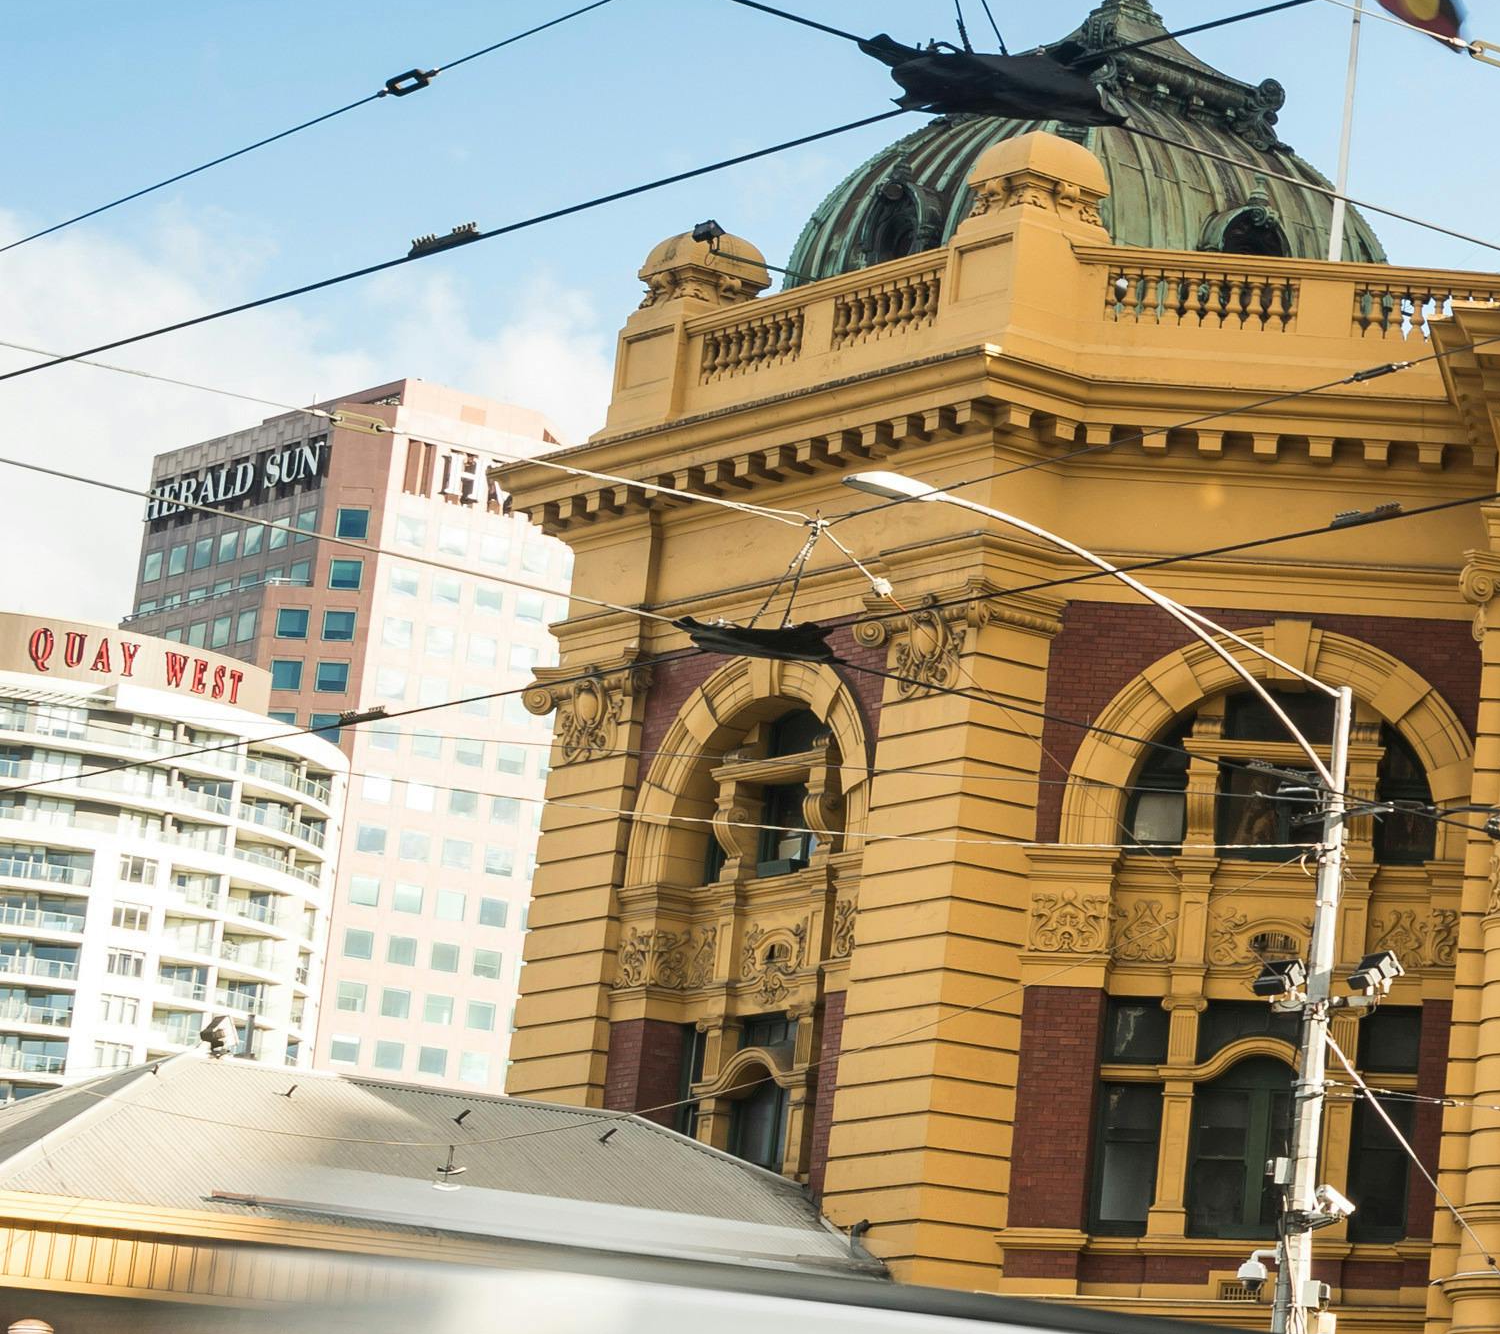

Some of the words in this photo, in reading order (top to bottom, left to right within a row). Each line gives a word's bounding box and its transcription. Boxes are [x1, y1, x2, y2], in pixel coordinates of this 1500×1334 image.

[143, 461, 255, 523] HERALD
[263, 441, 325, 490] SUN
[29, 627, 141, 677] QUAY
[165, 651, 244, 705] WEST
